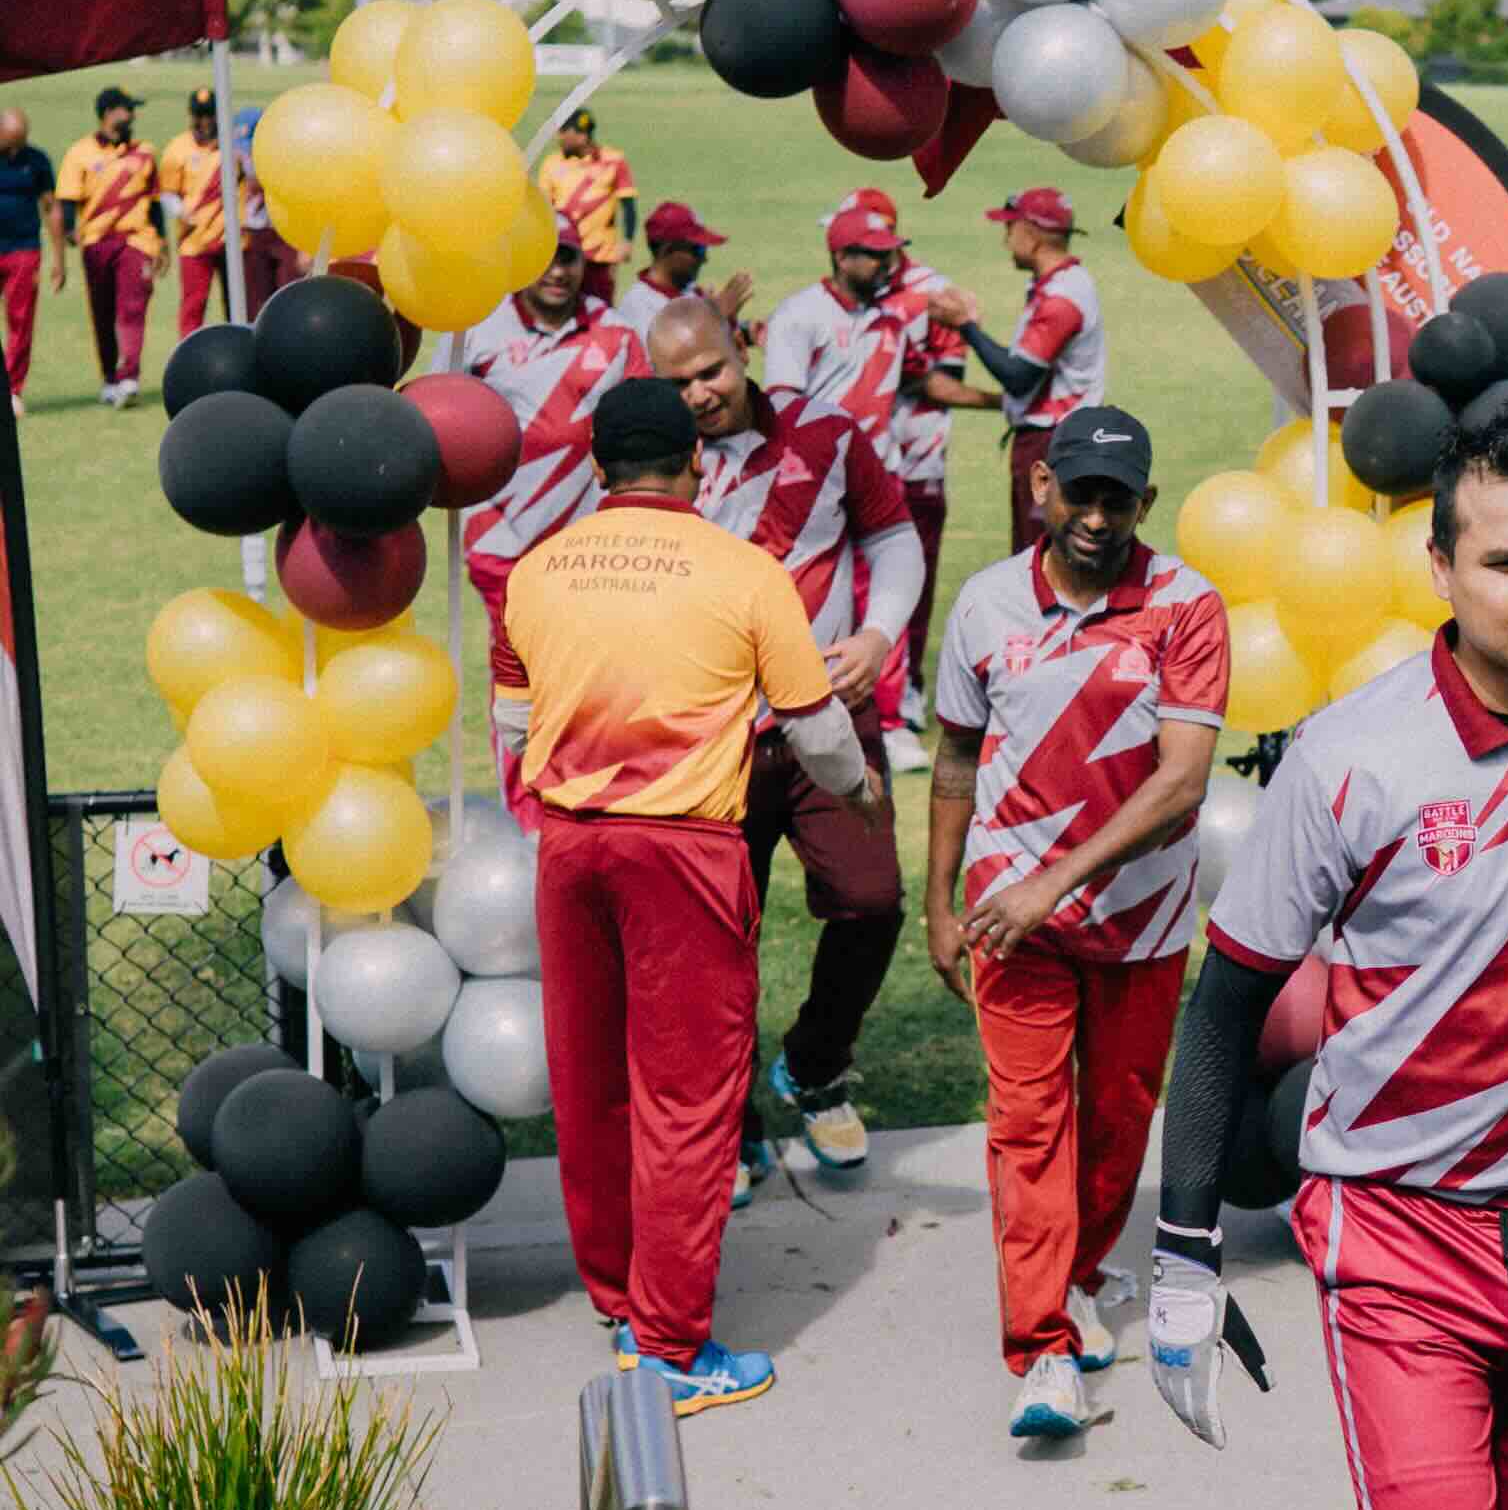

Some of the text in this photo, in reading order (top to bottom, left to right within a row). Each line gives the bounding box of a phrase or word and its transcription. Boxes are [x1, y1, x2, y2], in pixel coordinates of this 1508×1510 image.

[546, 554, 693, 576] MAROONS
[567, 577, 657, 593] AUSTRALIA
[1423, 805, 1465, 819] BATTLE
[1419, 830, 1475, 844] MAROONS
